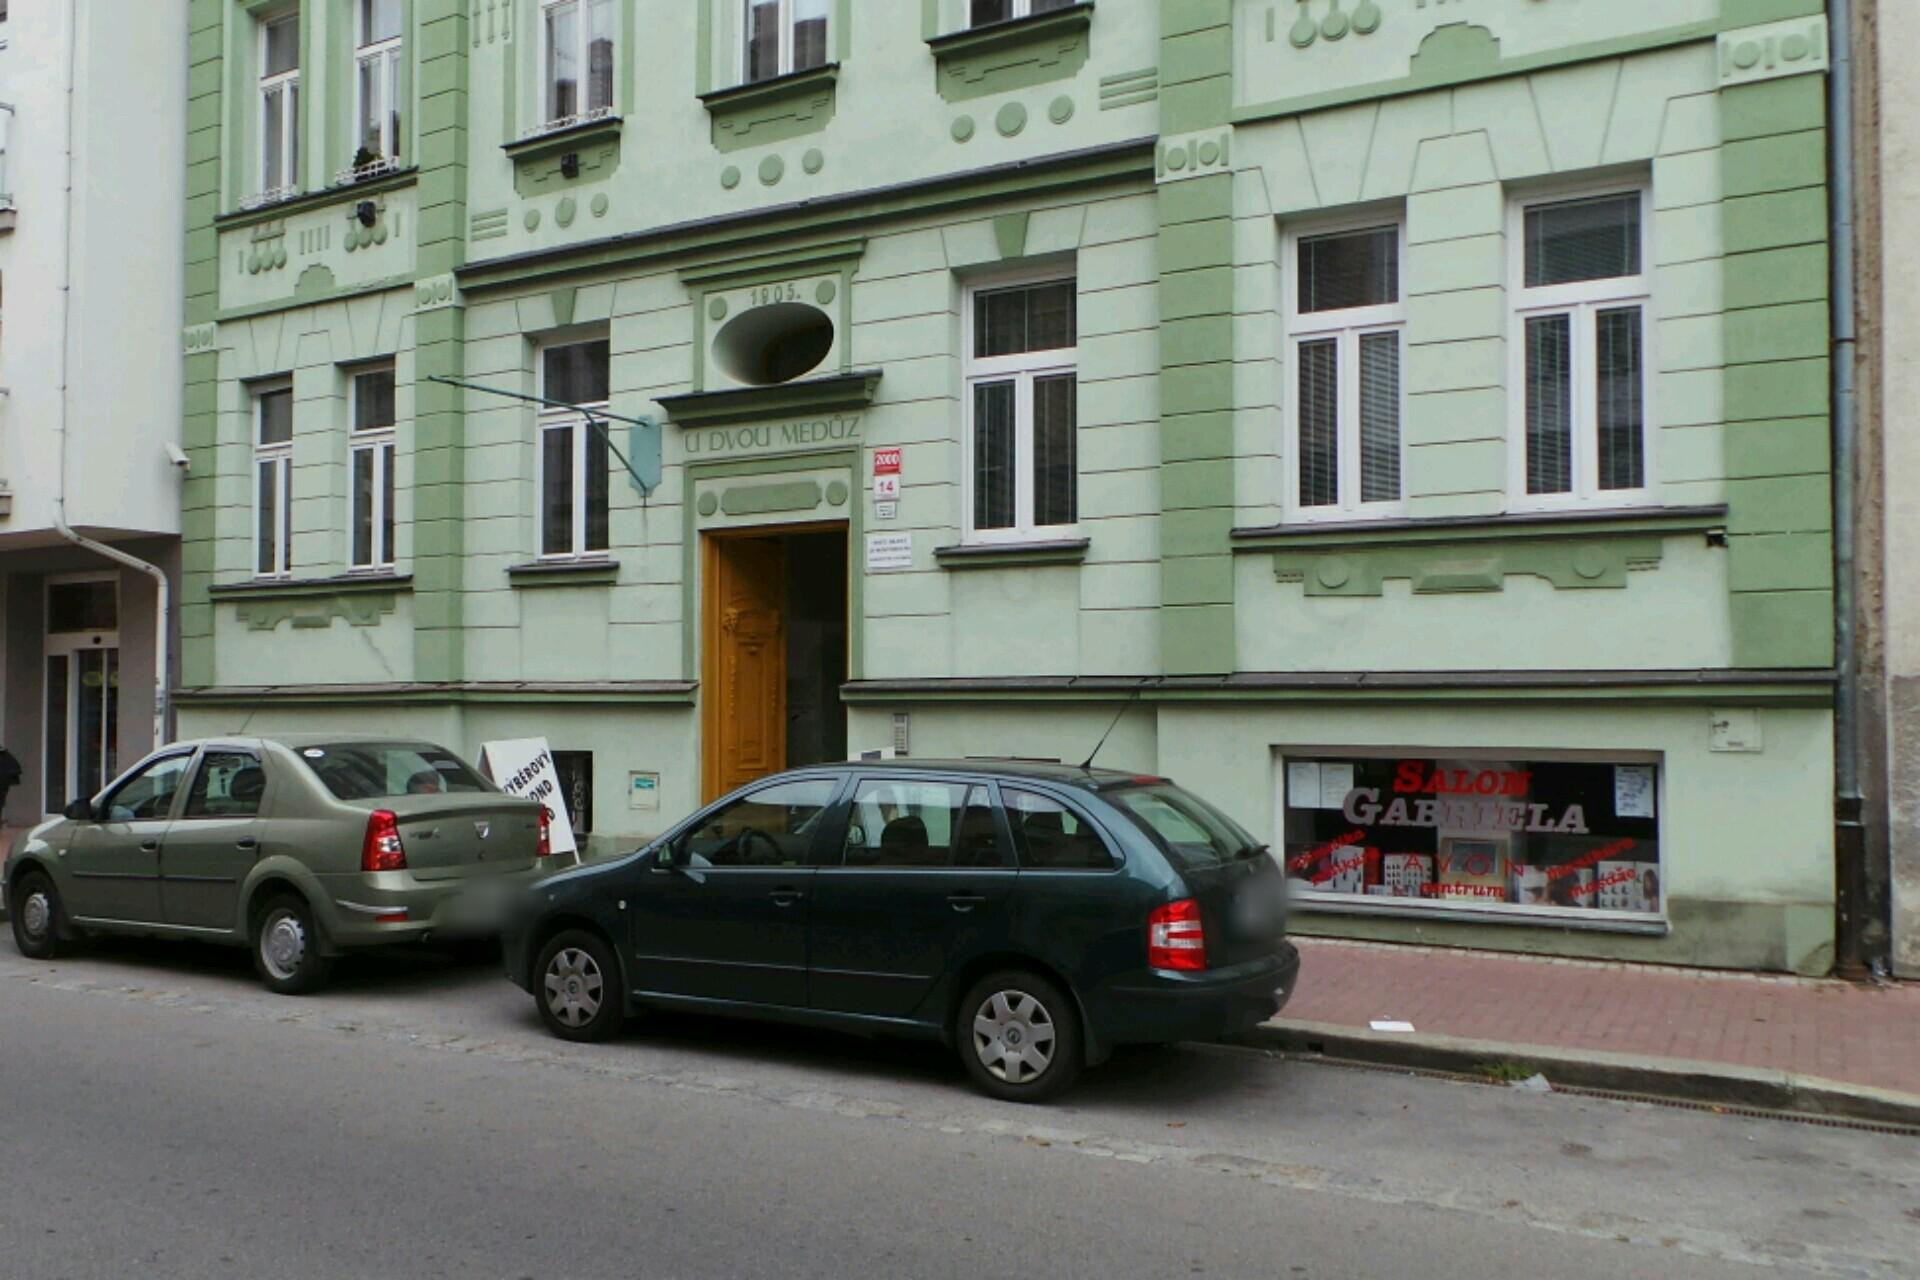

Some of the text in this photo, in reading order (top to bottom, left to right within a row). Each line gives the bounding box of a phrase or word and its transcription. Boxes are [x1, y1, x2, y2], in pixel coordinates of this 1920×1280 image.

[684, 414, 861, 453] U DVOU MEDŮZ
[880, 481, 893, 493] 14
[525, 779, 553, 801] OND
[1393, 760, 1534, 796] SALON
[1343, 787, 1590, 834] GABRIELA
[1403, 854, 1524, 877] AVON
